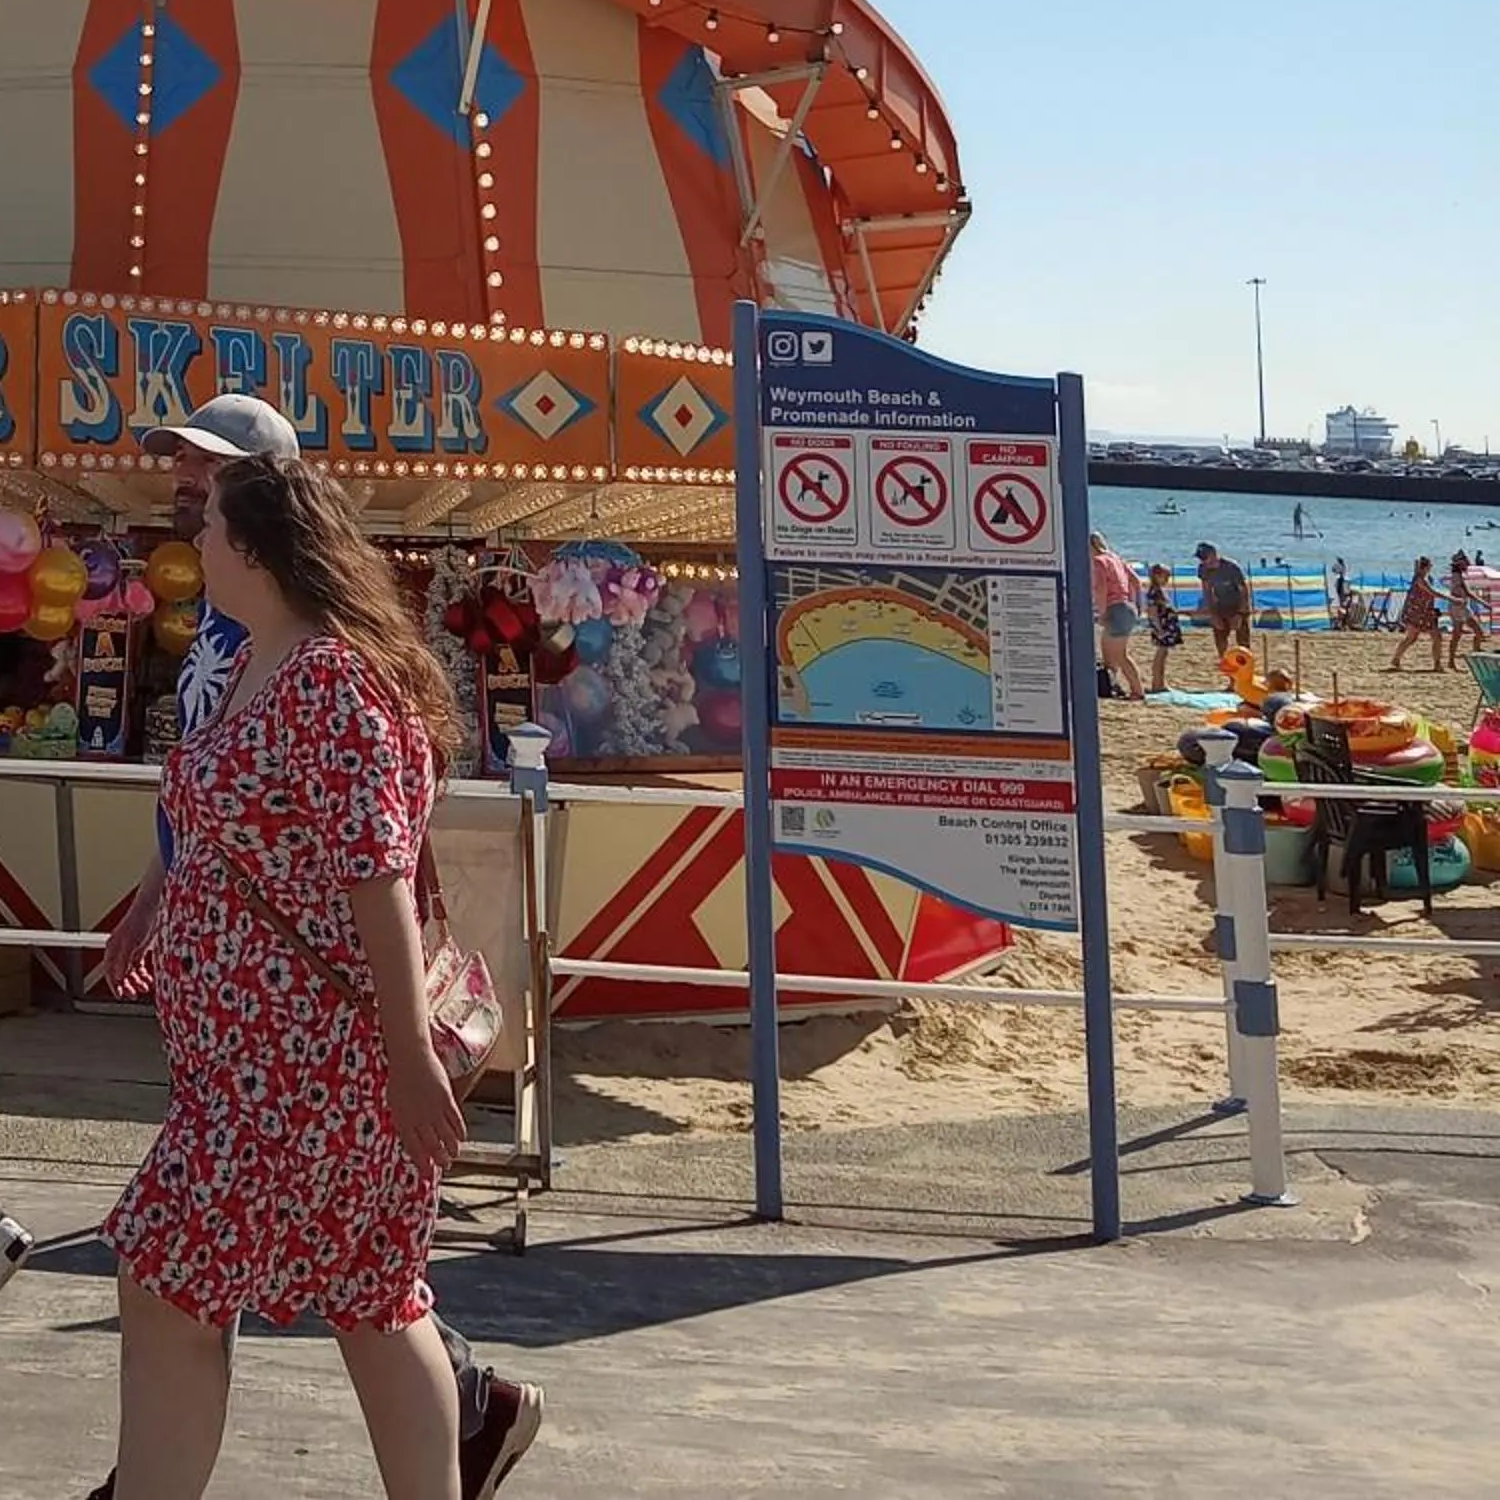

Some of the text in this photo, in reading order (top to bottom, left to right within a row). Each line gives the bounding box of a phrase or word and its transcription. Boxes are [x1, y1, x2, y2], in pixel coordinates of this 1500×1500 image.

[59, 310, 489, 455] SKELTER
[769, 386, 942, 407] Weymouth Beach &
[770, 406, 977, 429] Promenade Information
[998, 445, 1017, 454] NO
[821, 773, 1025, 795] IN AN EMERGENCY DIAL 999
[939, 815, 1068, 832] Beach Control Office
[1000, 865, 1017, 875] The
